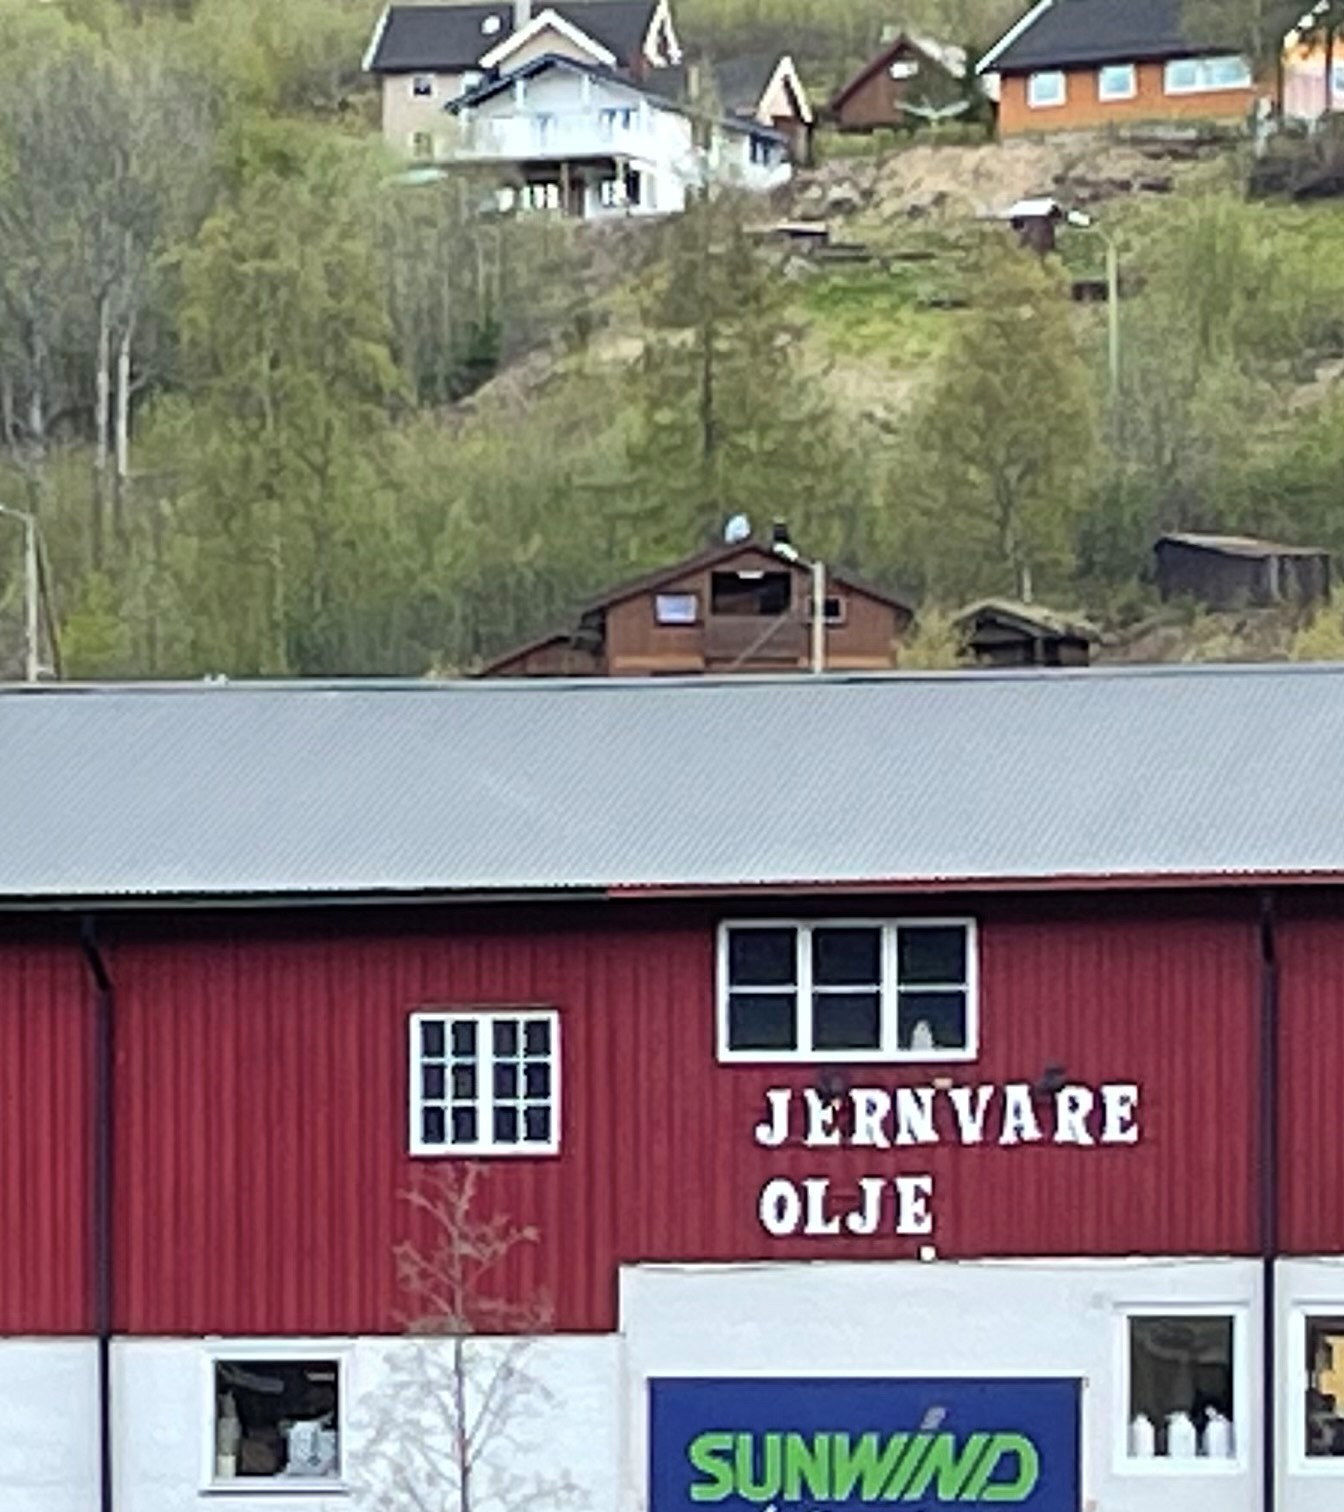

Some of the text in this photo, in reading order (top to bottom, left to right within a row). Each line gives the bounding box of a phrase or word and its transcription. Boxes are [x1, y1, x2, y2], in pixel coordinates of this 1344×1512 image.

[755, 1084, 1140, 1149] JERNVARE
[759, 1176, 934, 1235] OLJE
[688, 1405, 1040, 1502] SUNWIND
